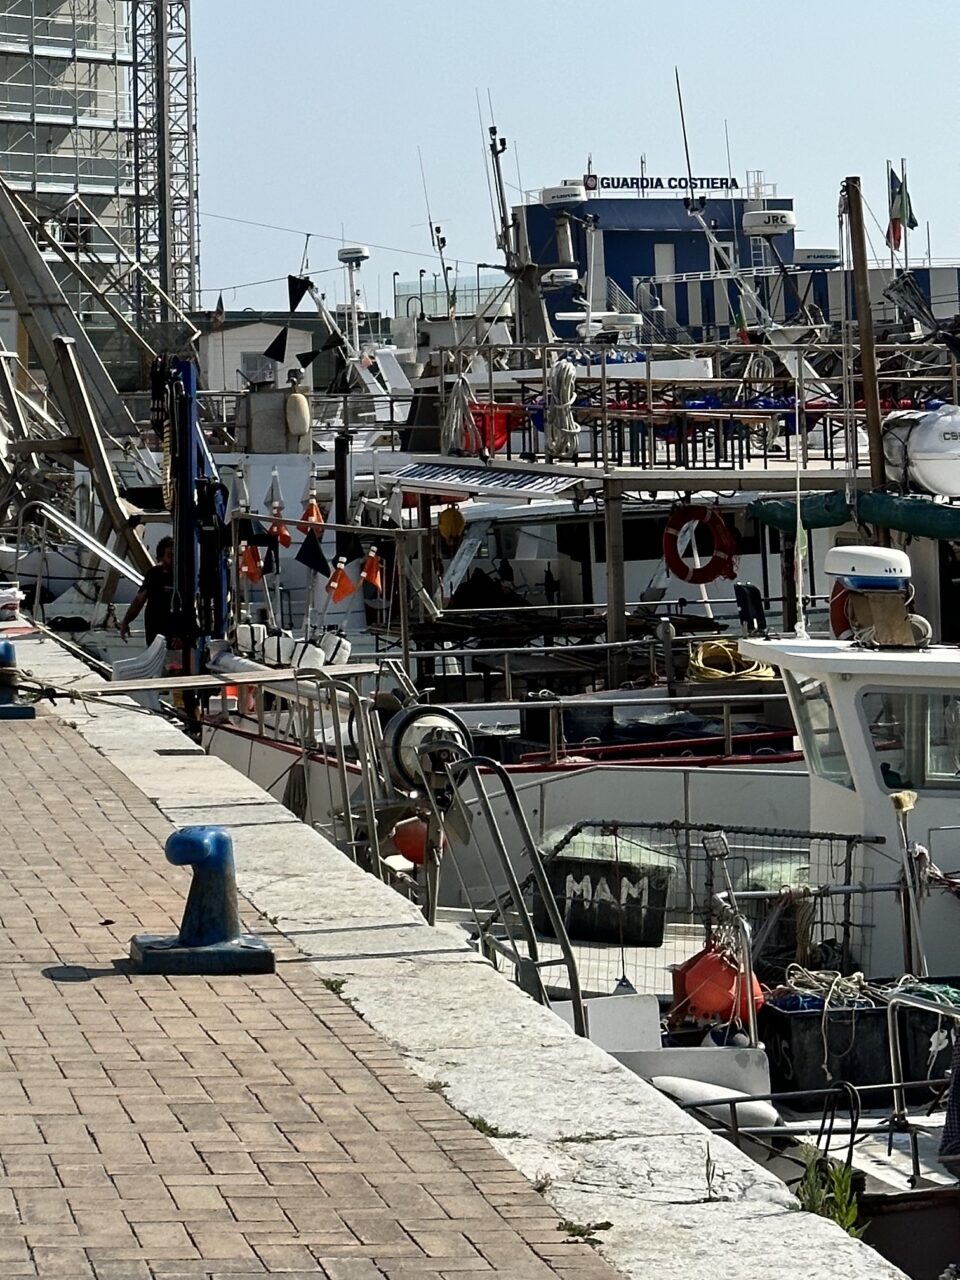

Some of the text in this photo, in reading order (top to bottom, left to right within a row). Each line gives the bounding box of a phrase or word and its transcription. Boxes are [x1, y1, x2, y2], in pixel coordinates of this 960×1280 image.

[600, 177, 739, 189] GUARDIA COSTIERA
[763, 215, 787, 225] JRC
[565, 874, 649, 915] MAM
